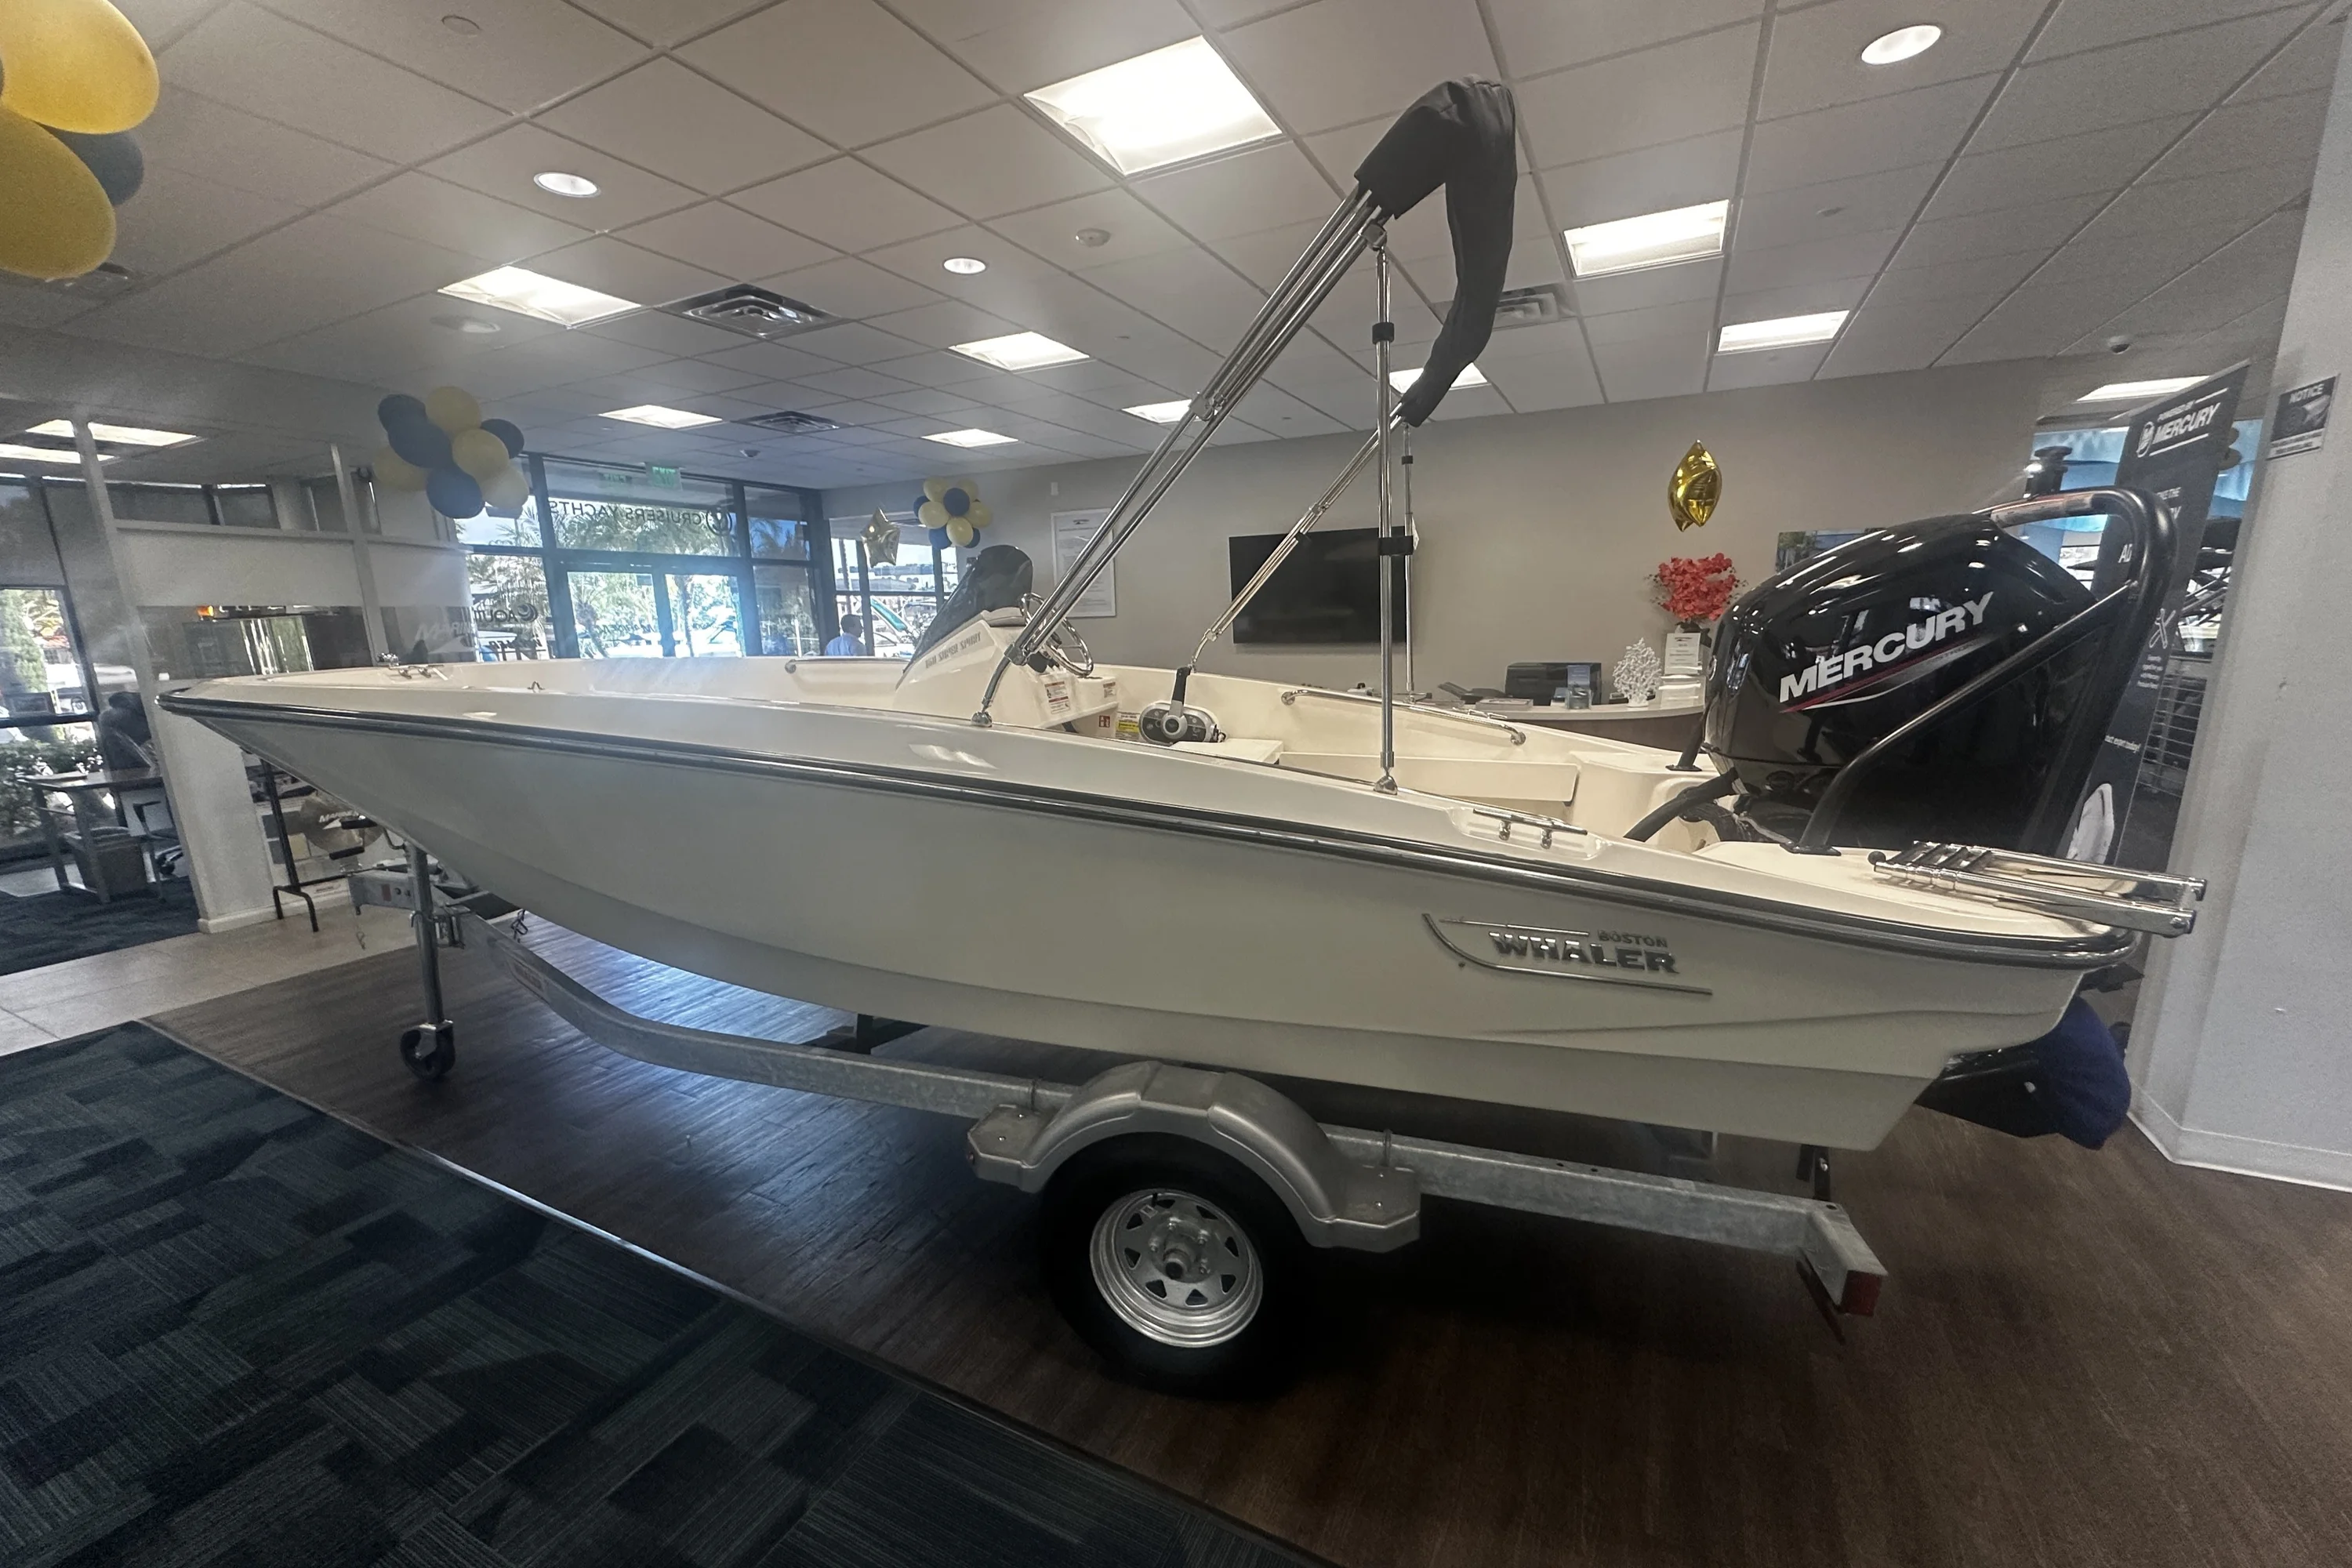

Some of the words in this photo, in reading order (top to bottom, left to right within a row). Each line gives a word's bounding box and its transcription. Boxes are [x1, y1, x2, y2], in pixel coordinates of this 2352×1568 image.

[2288, 383, 2325, 405] NOTICE
[2151, 401, 2221, 445] MERCURY
[1779, 591, 1994, 703] MERCURY
[1489, 931, 1680, 975] WHALER
[1597, 928, 1669, 949] BOSTON
